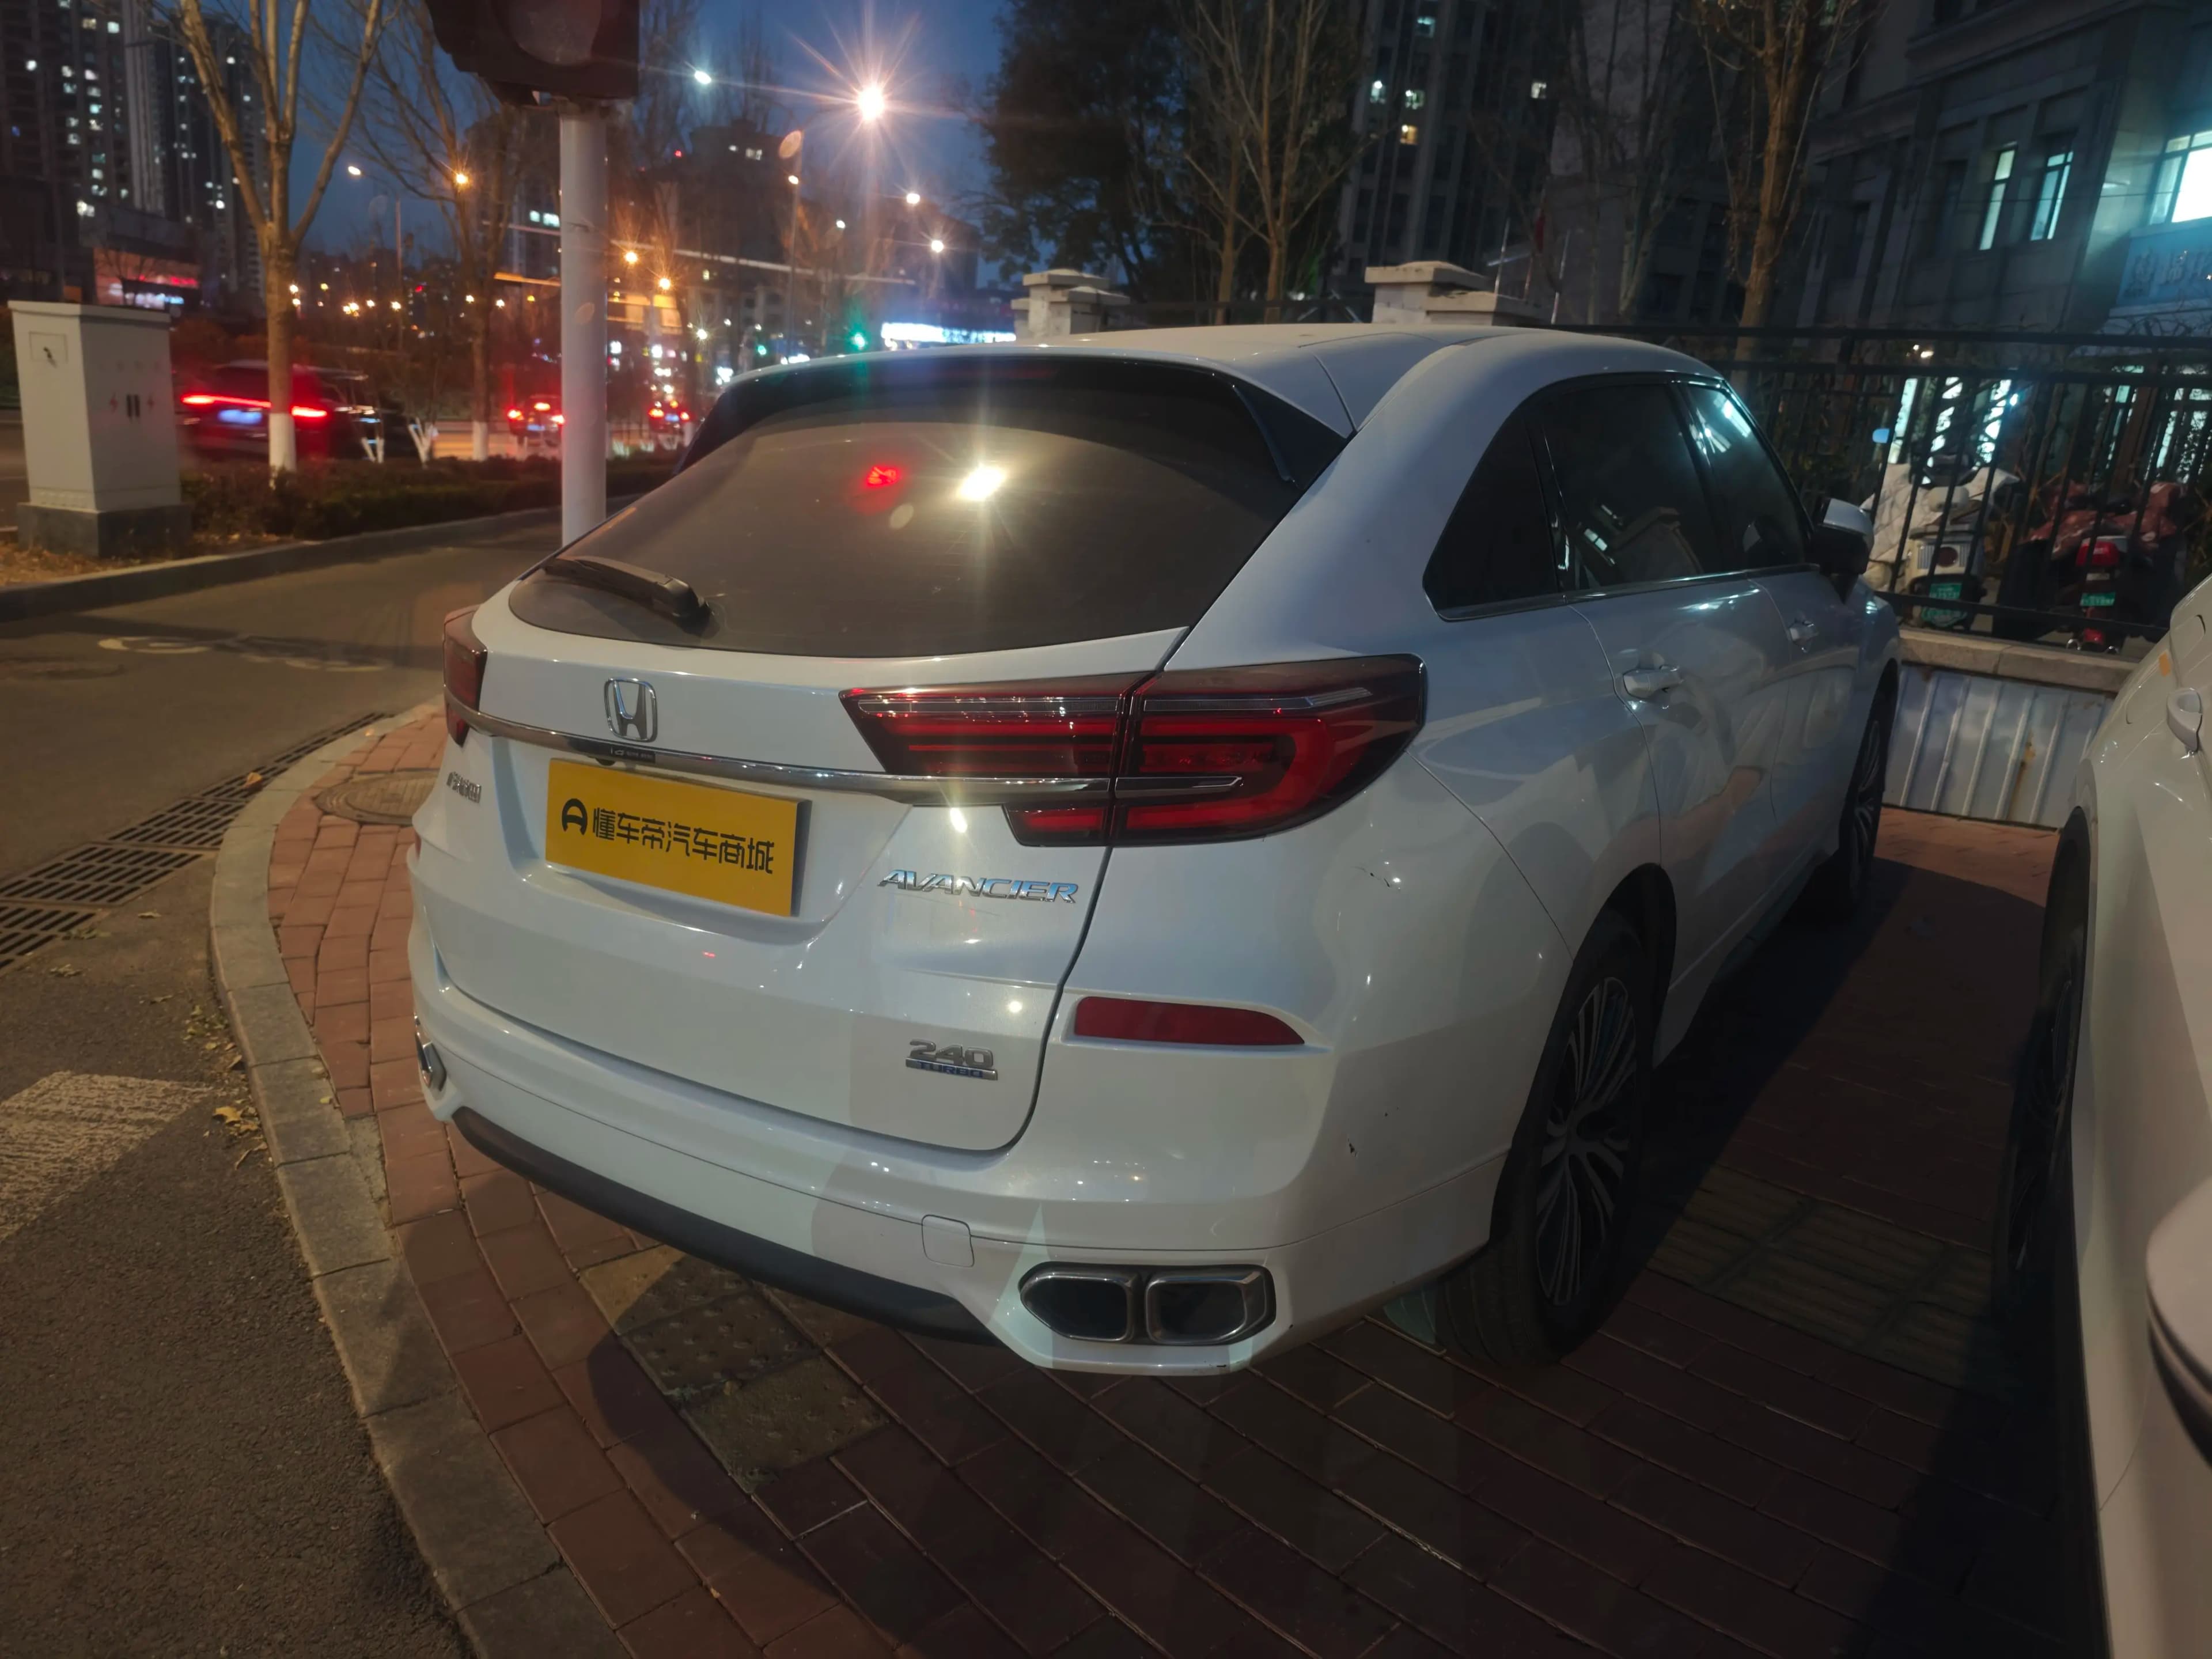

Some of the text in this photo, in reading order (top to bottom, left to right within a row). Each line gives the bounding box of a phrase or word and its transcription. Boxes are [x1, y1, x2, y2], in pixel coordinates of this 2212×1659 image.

[593, 807, 774, 874] 懂车帝汽车商城
[877, 869, 1078, 903] AVANCIER
[909, 1039, 994, 1068] 240
